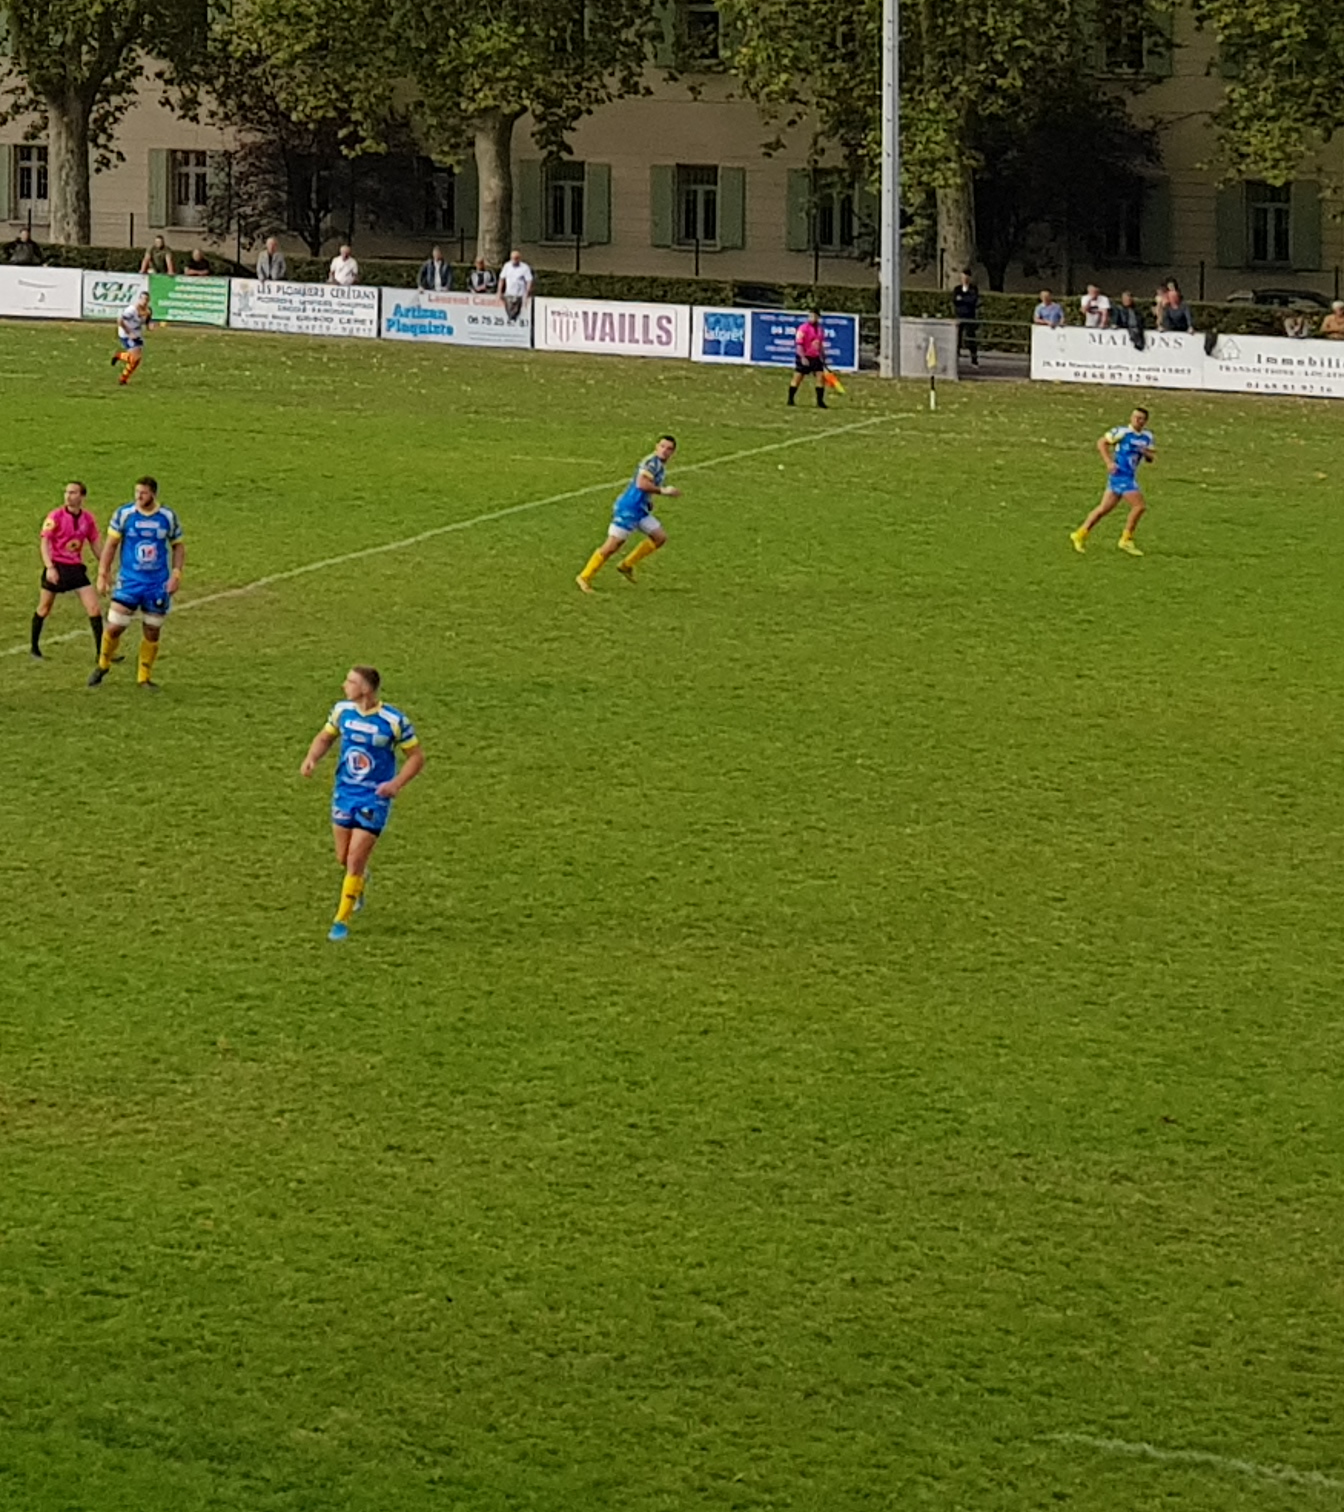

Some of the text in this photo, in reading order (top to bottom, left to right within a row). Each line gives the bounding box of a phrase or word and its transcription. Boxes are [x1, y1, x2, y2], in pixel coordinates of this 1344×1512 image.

[393, 303, 448, 321] Artisan
[385, 318, 454, 337] Plaquiste
[582, 310, 673, 347] VAILLS
[1088, 332, 1184, 350] MAIONS
[1128, 374, 1141, 382] 12
